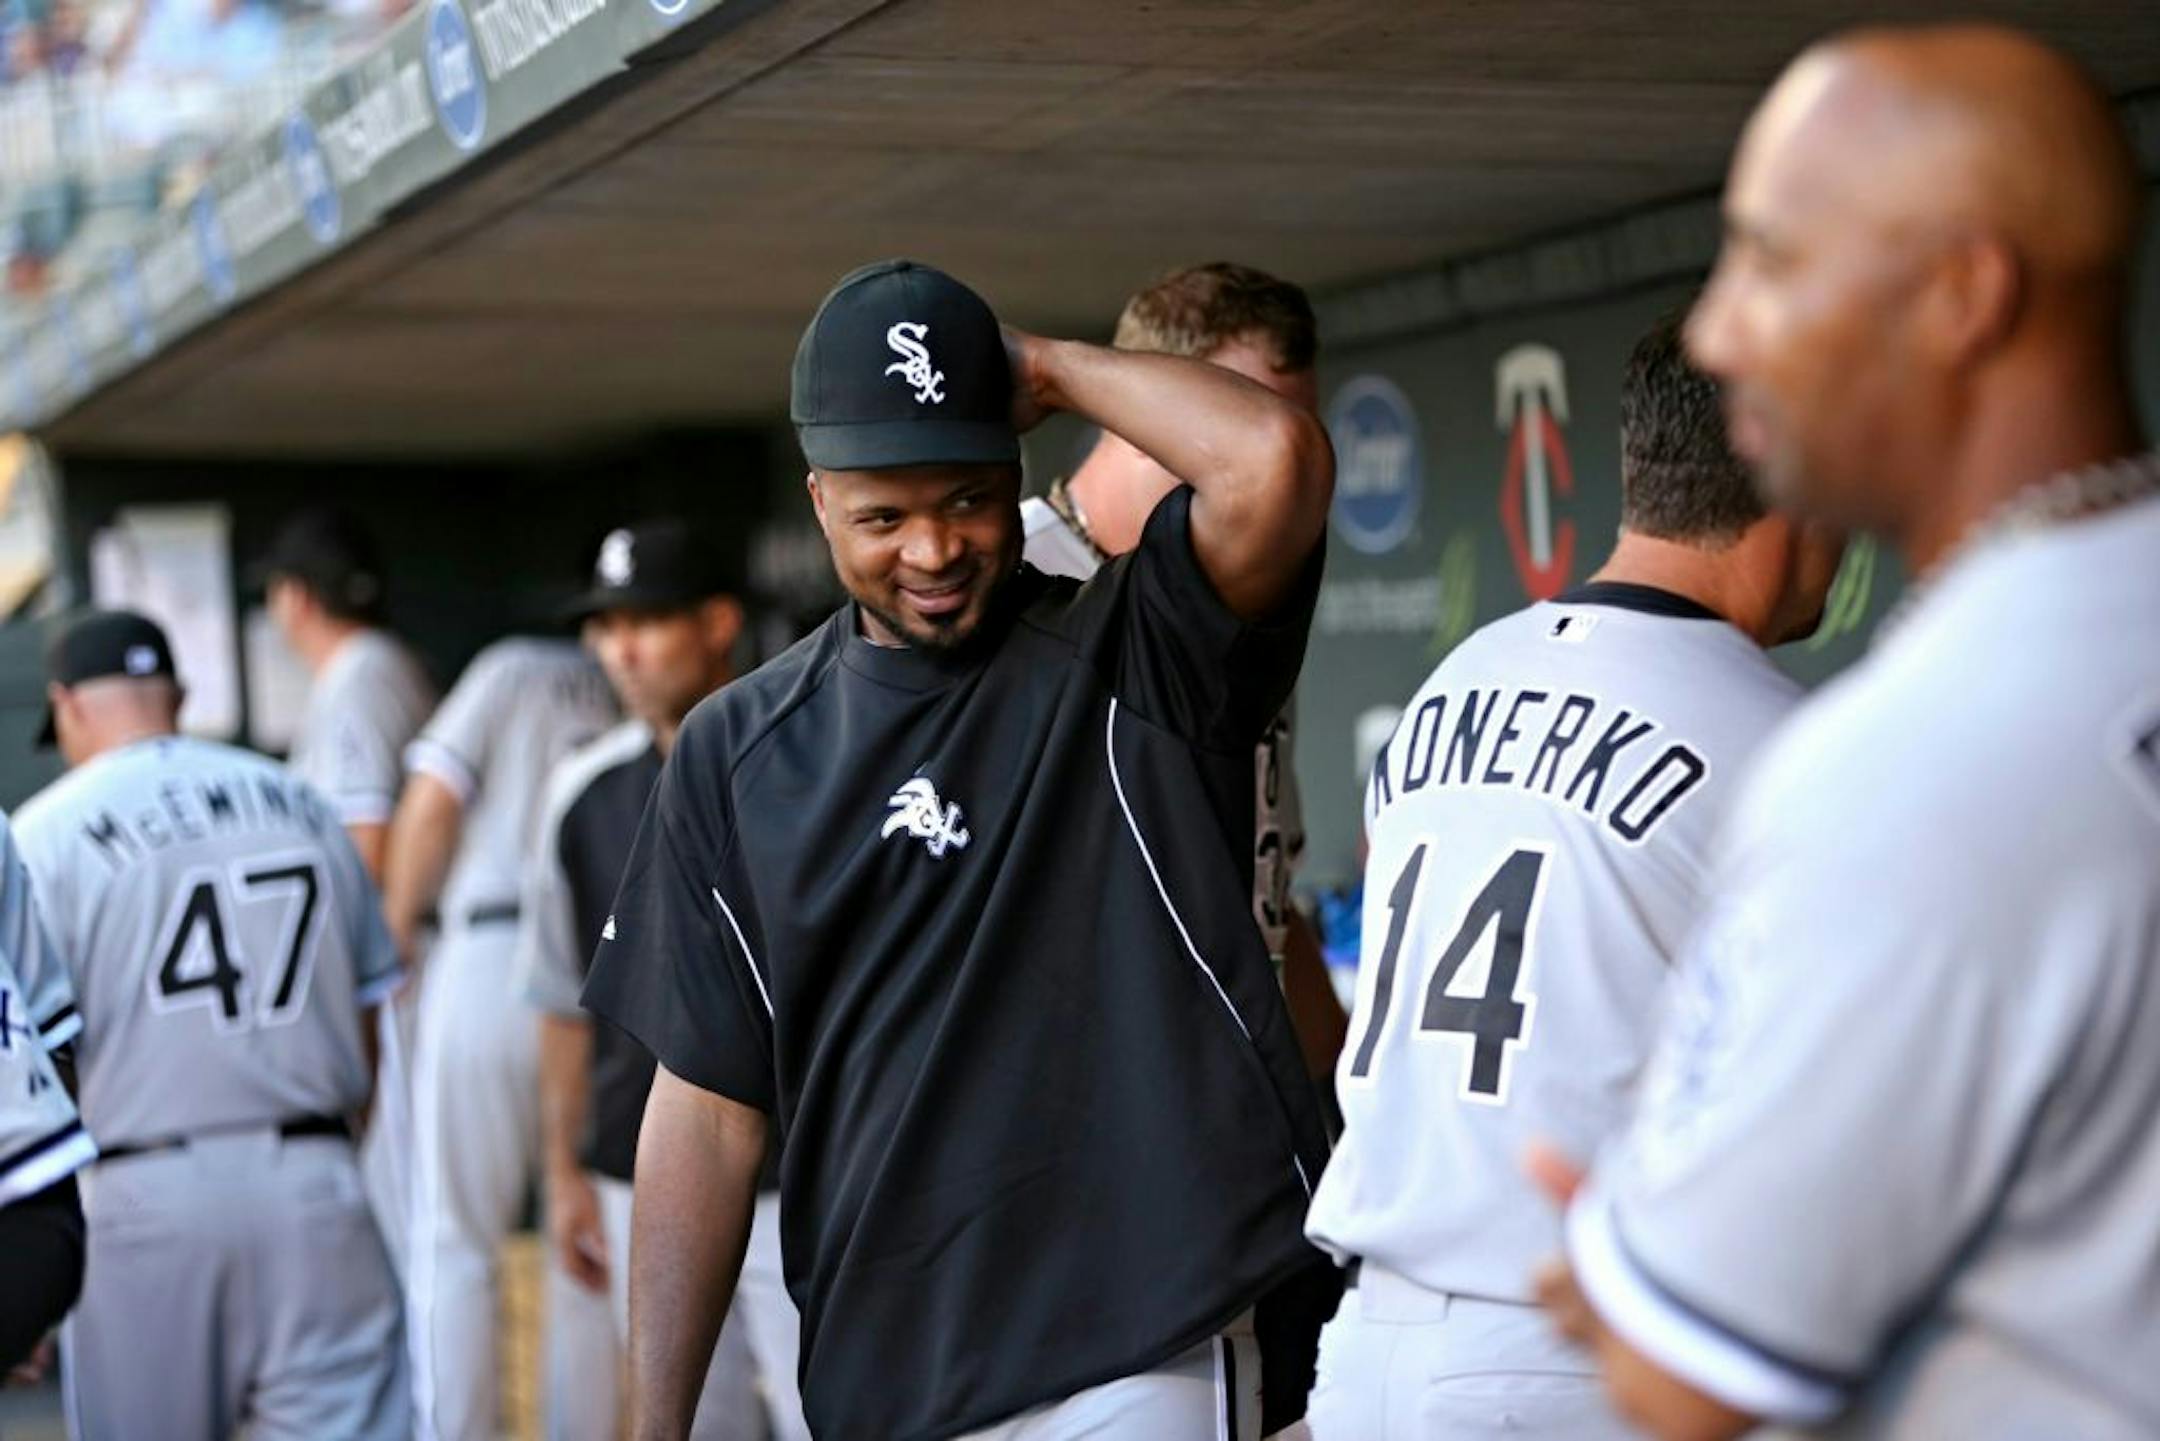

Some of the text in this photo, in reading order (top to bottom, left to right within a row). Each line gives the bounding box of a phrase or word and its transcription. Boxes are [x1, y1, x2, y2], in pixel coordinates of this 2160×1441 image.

[1373, 688, 1706, 842] KONERKO
[155, 861, 322, 1022] 47
[1347, 841, 1547, 1098] 14
